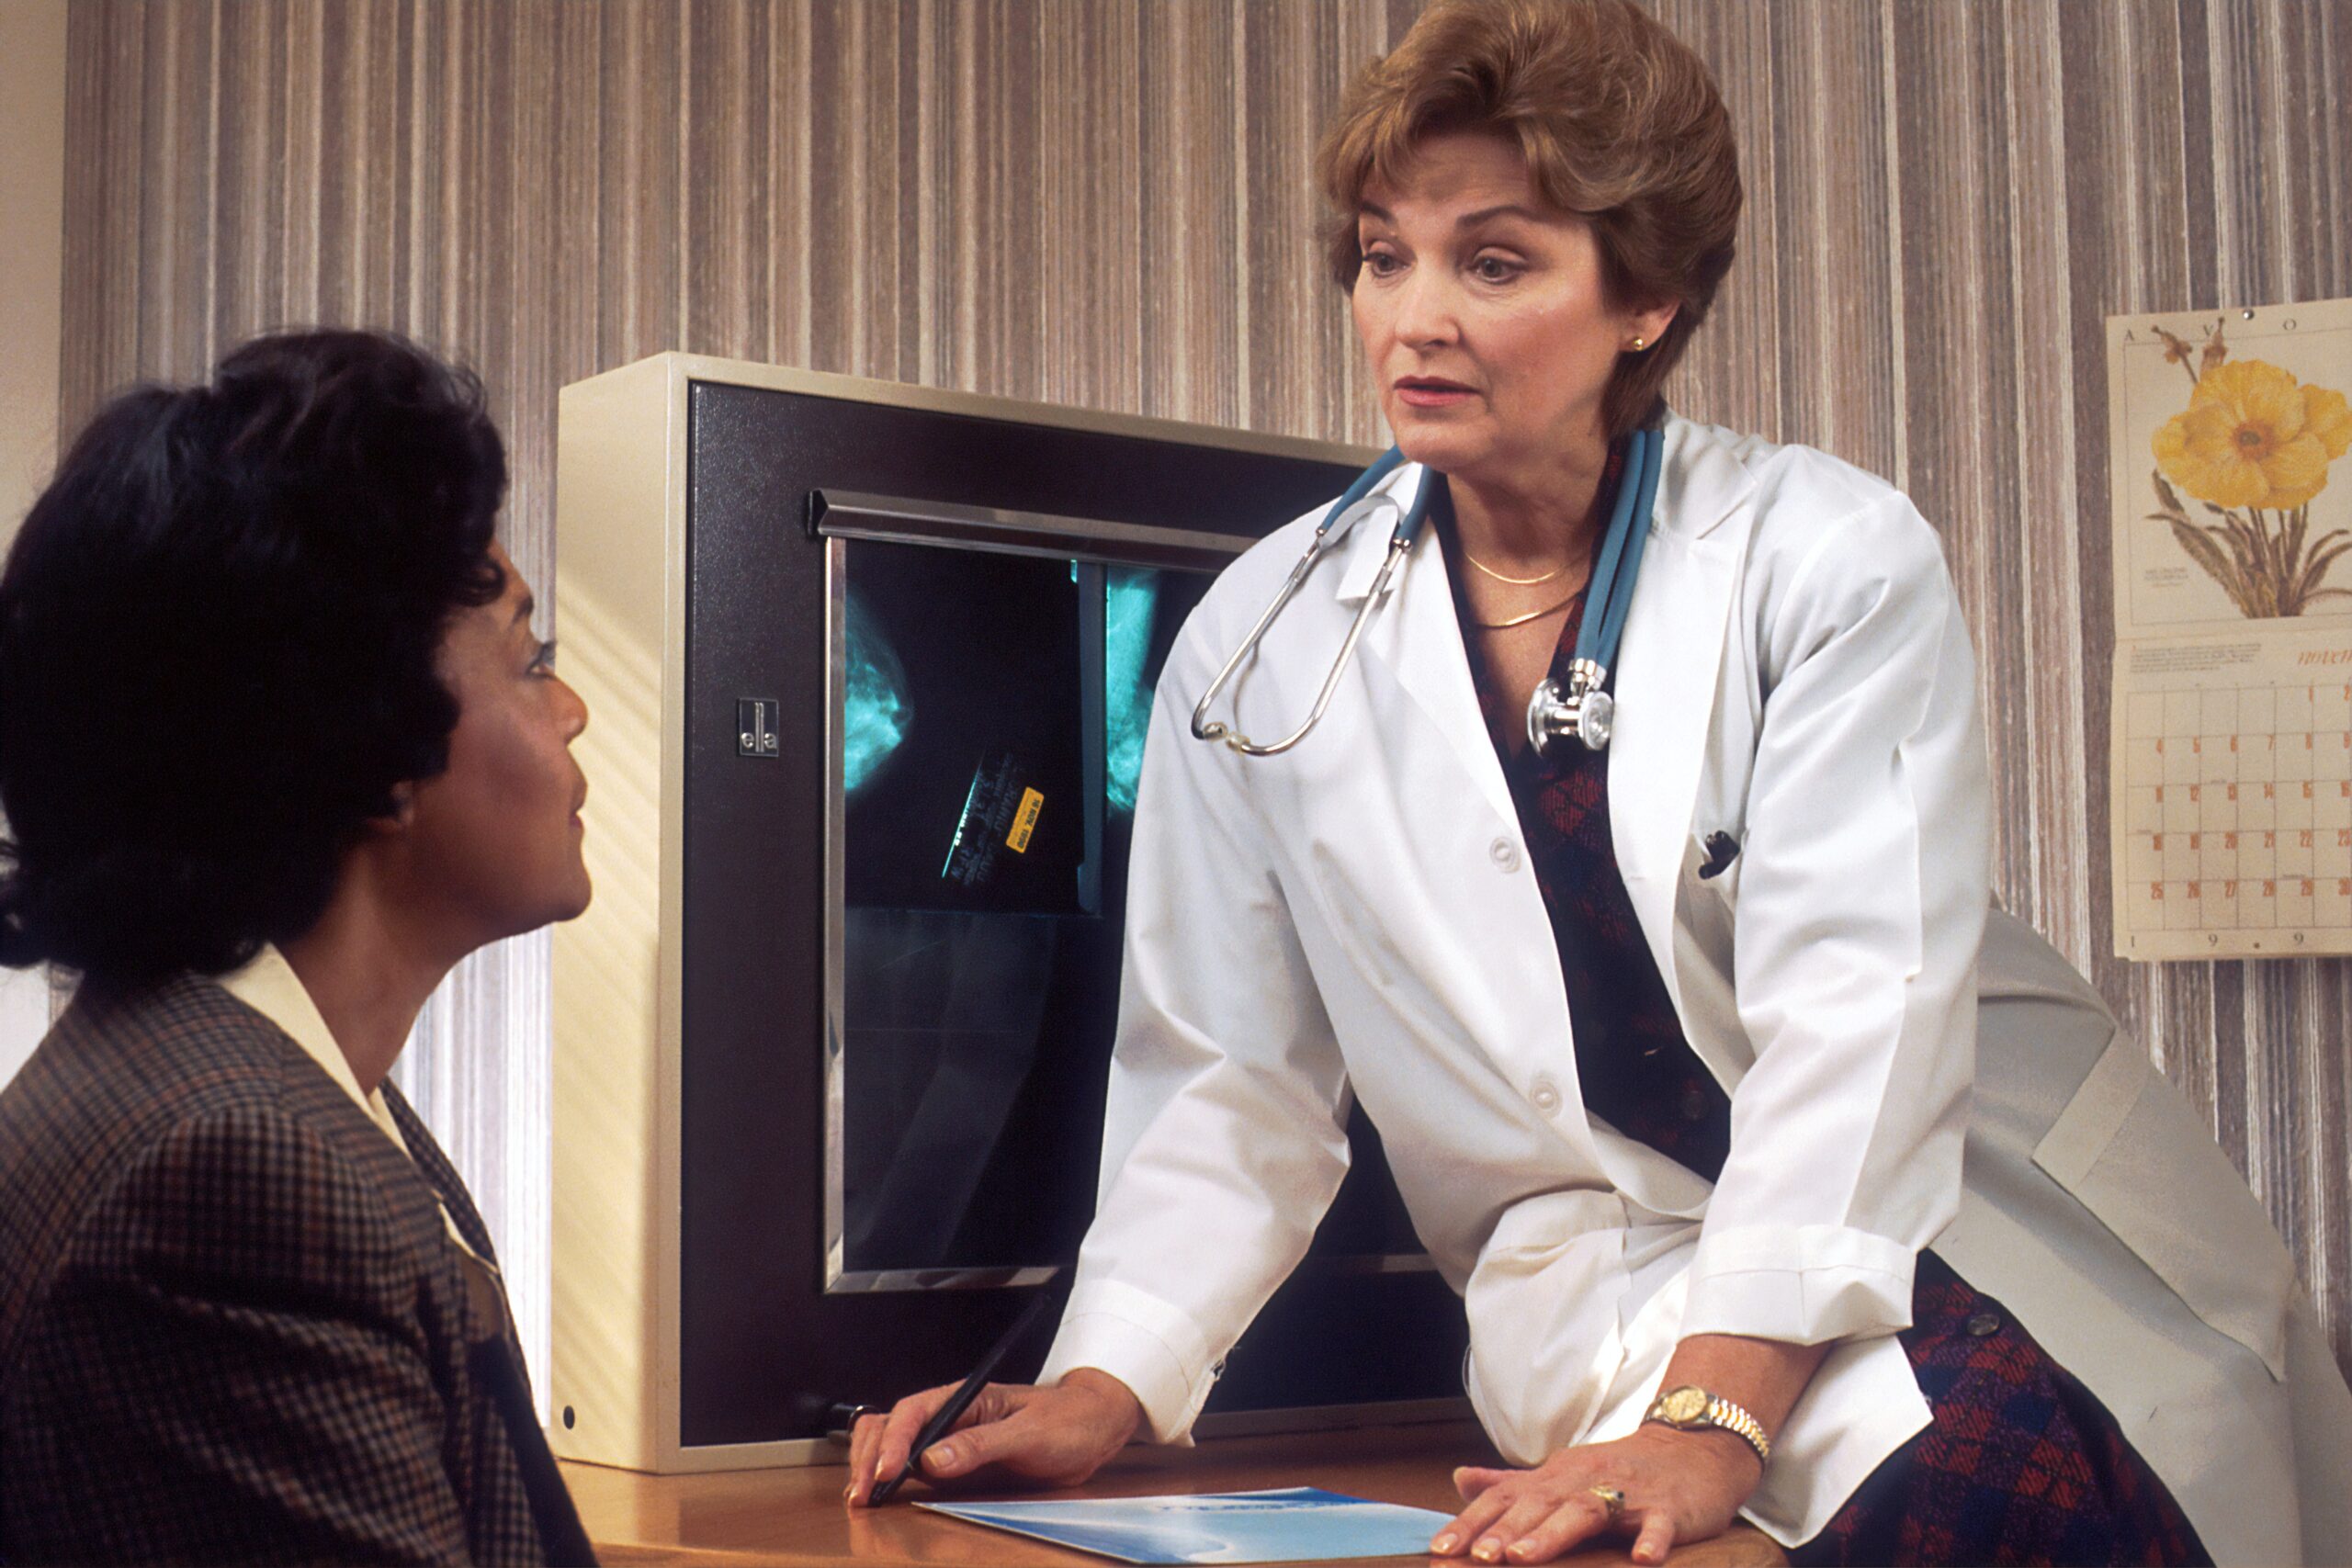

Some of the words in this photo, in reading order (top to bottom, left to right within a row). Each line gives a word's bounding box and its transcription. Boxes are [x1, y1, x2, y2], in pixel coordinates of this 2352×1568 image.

[2125, 329, 2134, 341] A
[2202, 324, 2213, 336] V
[2282, 318, 2297, 331] O
[2267, 735, 2275, 750] 7
[2190, 785, 2200, 802] 12
[2264, 784, 2274, 799] 14
[2225, 832, 2237, 849] 20
[2300, 830, 2312, 848] 22
[2338, 829, 2351, 847] 23
[2151, 882, 2163, 899] 25
[2188, 881, 2200, 899] 26
[2225, 880, 2237, 898] 27
[2263, 880, 2275, 897] 28
[2301, 879, 2312, 897] 29
